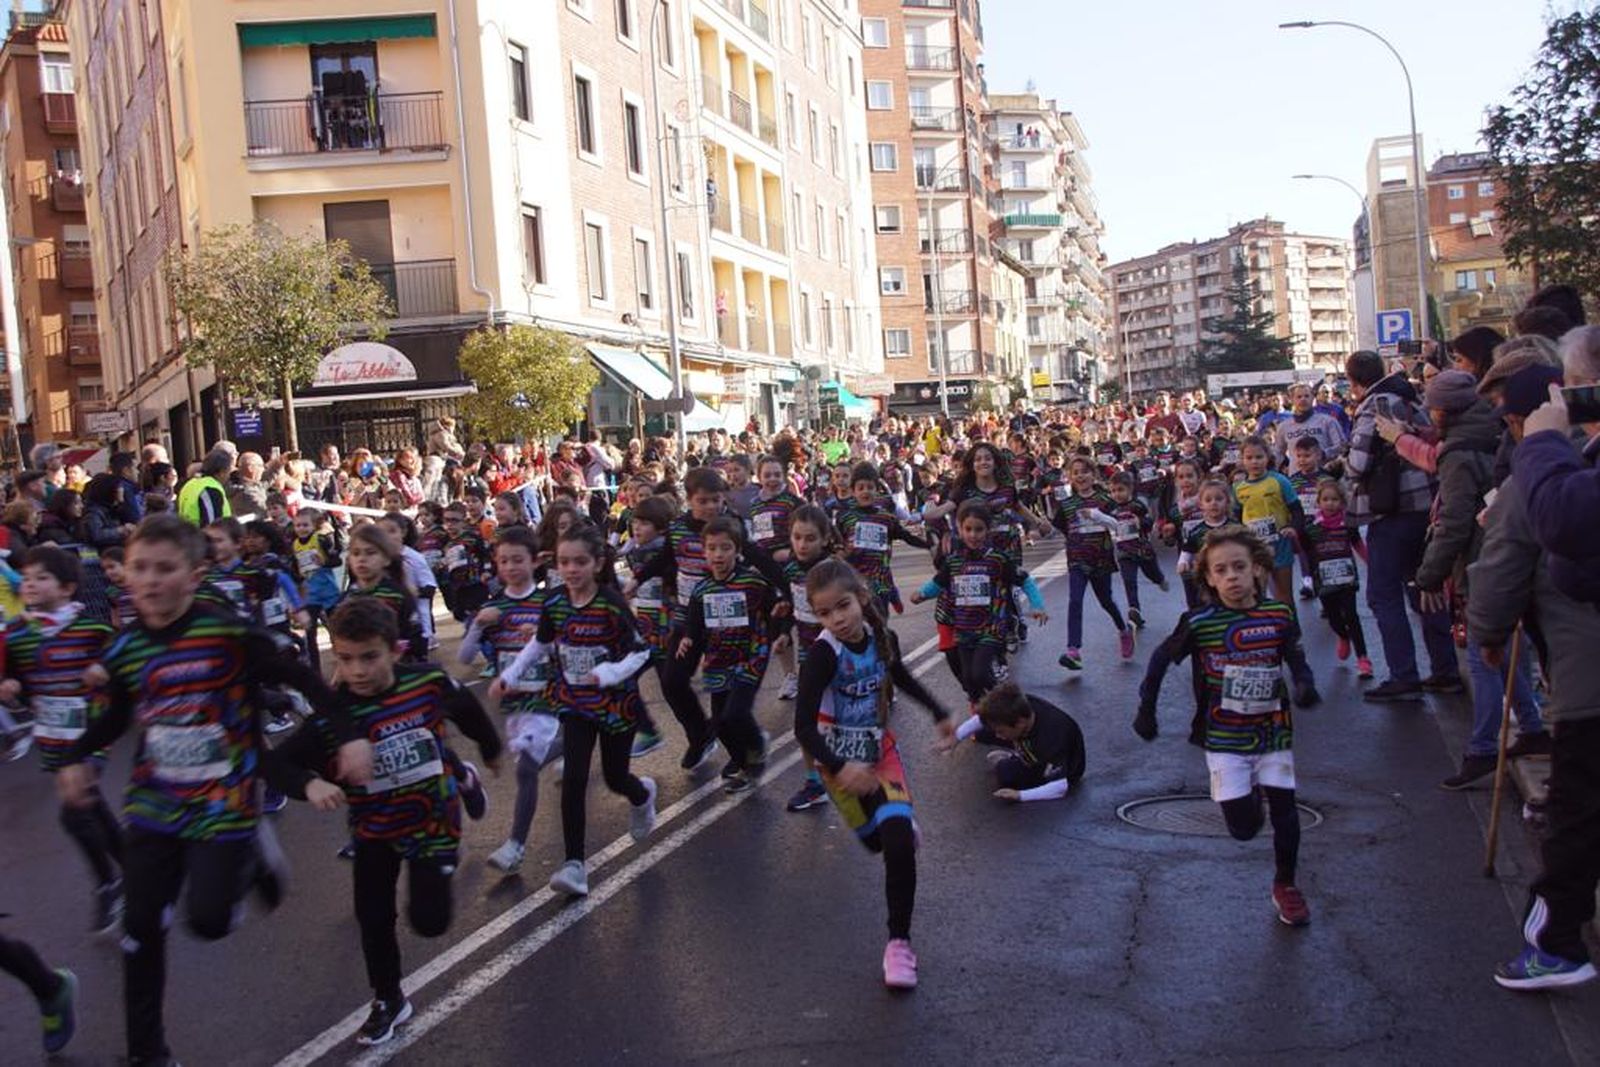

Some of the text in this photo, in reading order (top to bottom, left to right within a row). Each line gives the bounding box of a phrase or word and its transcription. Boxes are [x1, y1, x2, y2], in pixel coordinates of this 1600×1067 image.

[1383, 314, 1404, 341] P
[1287, 427, 1322, 440] adidas
[1231, 679, 1273, 698] 6268
